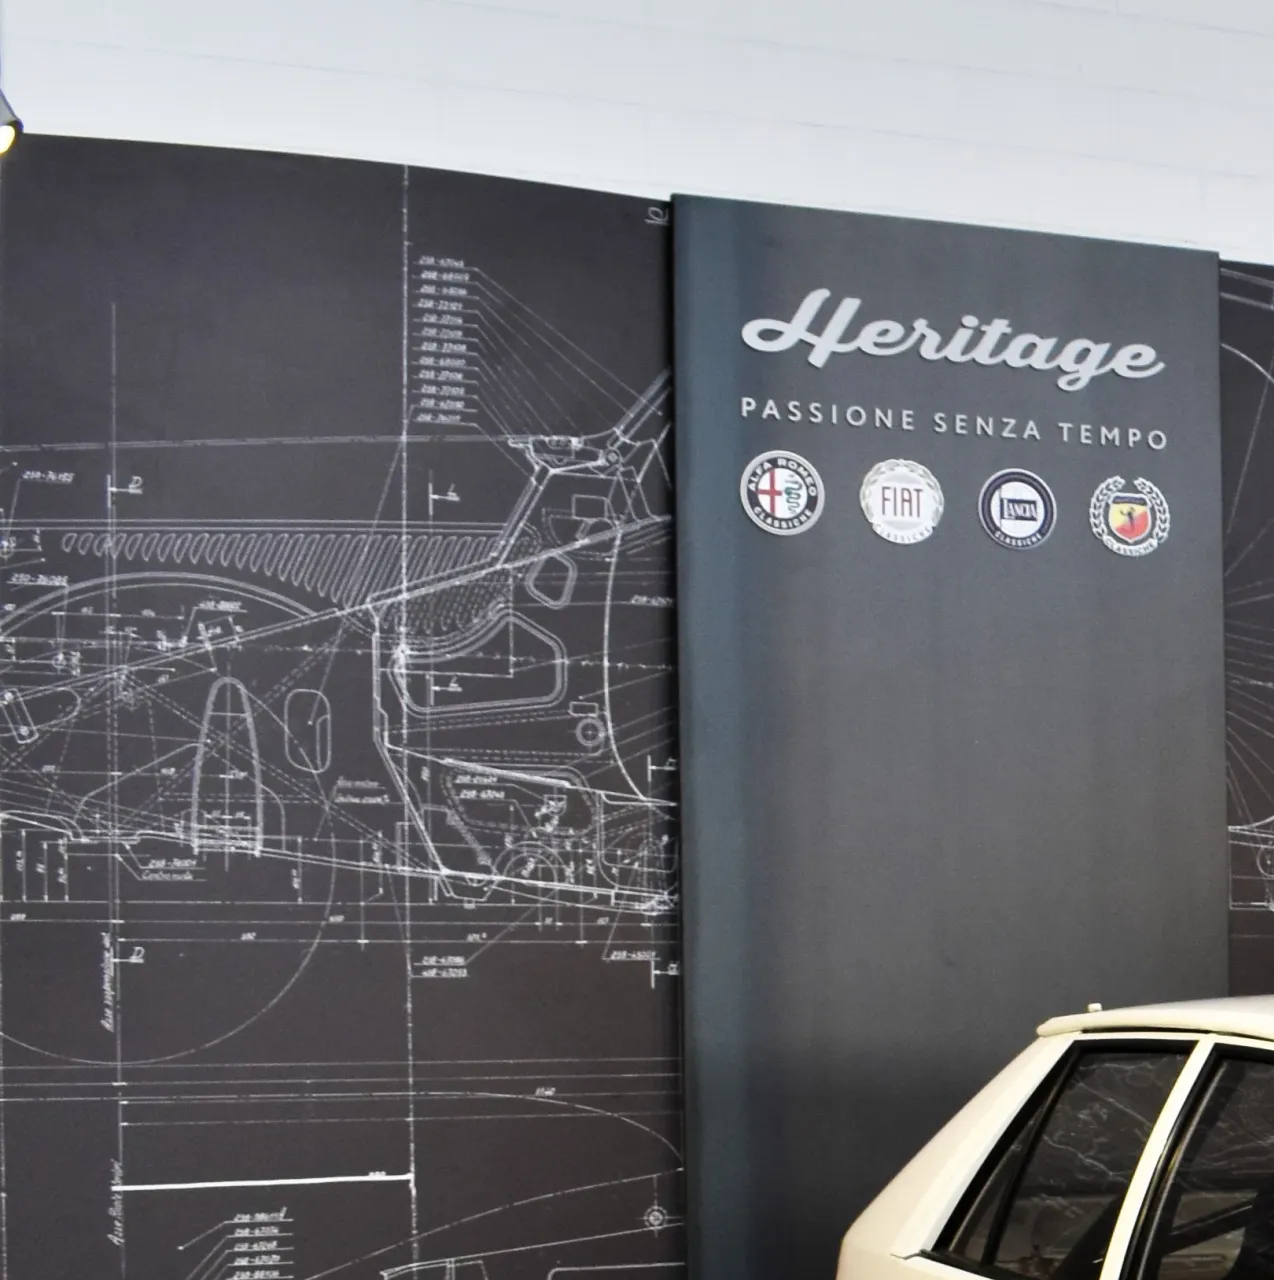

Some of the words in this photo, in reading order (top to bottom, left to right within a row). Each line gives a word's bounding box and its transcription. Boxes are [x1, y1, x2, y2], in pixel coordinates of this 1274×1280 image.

[741, 288, 1166, 391] Heritage
[741, 397, 915, 431] PASSIONE
[934, 412, 1041, 440] SENZA
[1058, 422, 1167, 450] TEMPO
[748, 461, 773, 492] ALFA
[777, 458, 818, 497] ROMEO
[881, 486, 923, 518] FIAT
[1002, 498, 1038, 520] LANCIA
